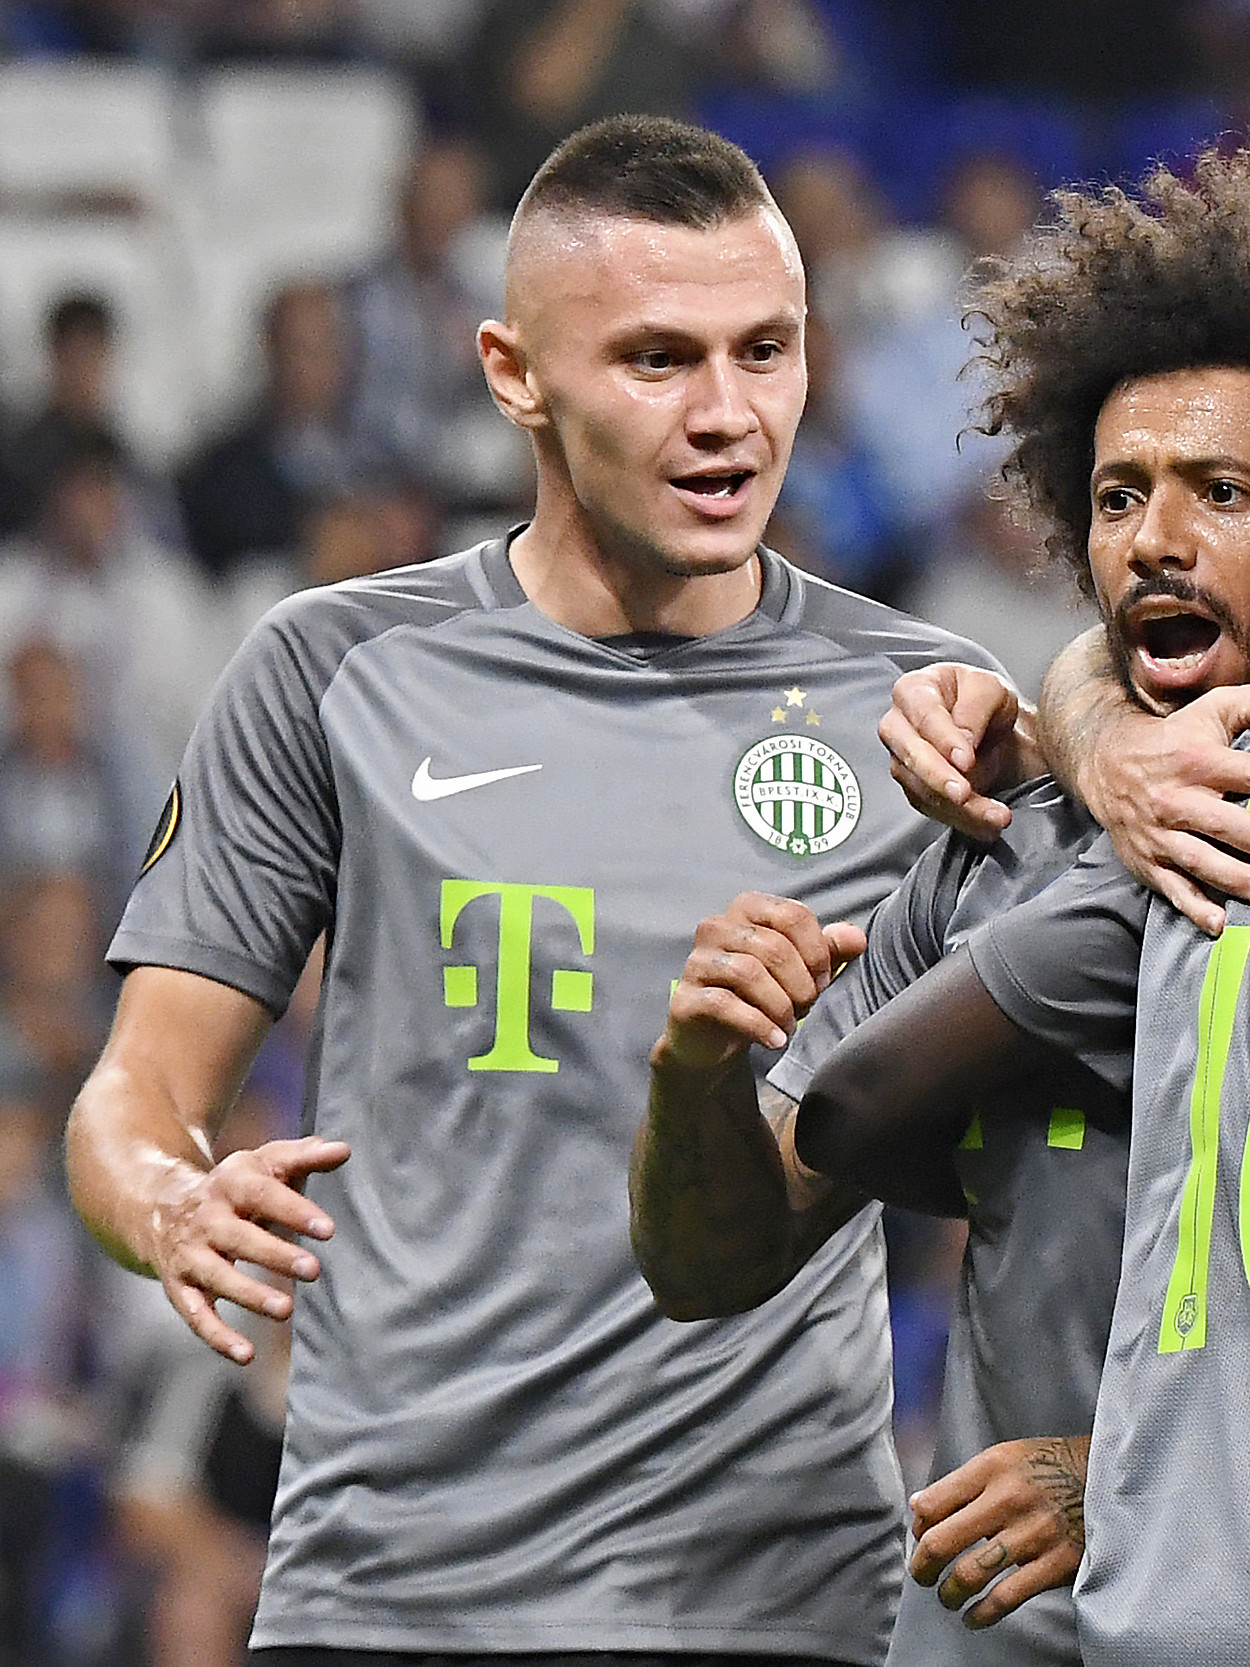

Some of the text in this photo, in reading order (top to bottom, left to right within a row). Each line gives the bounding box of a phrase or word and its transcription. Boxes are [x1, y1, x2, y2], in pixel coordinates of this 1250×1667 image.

[808, 742, 849, 781] TORNA
[845, 785, 858, 821] CLUB
[439, 879, 595, 1073] T
